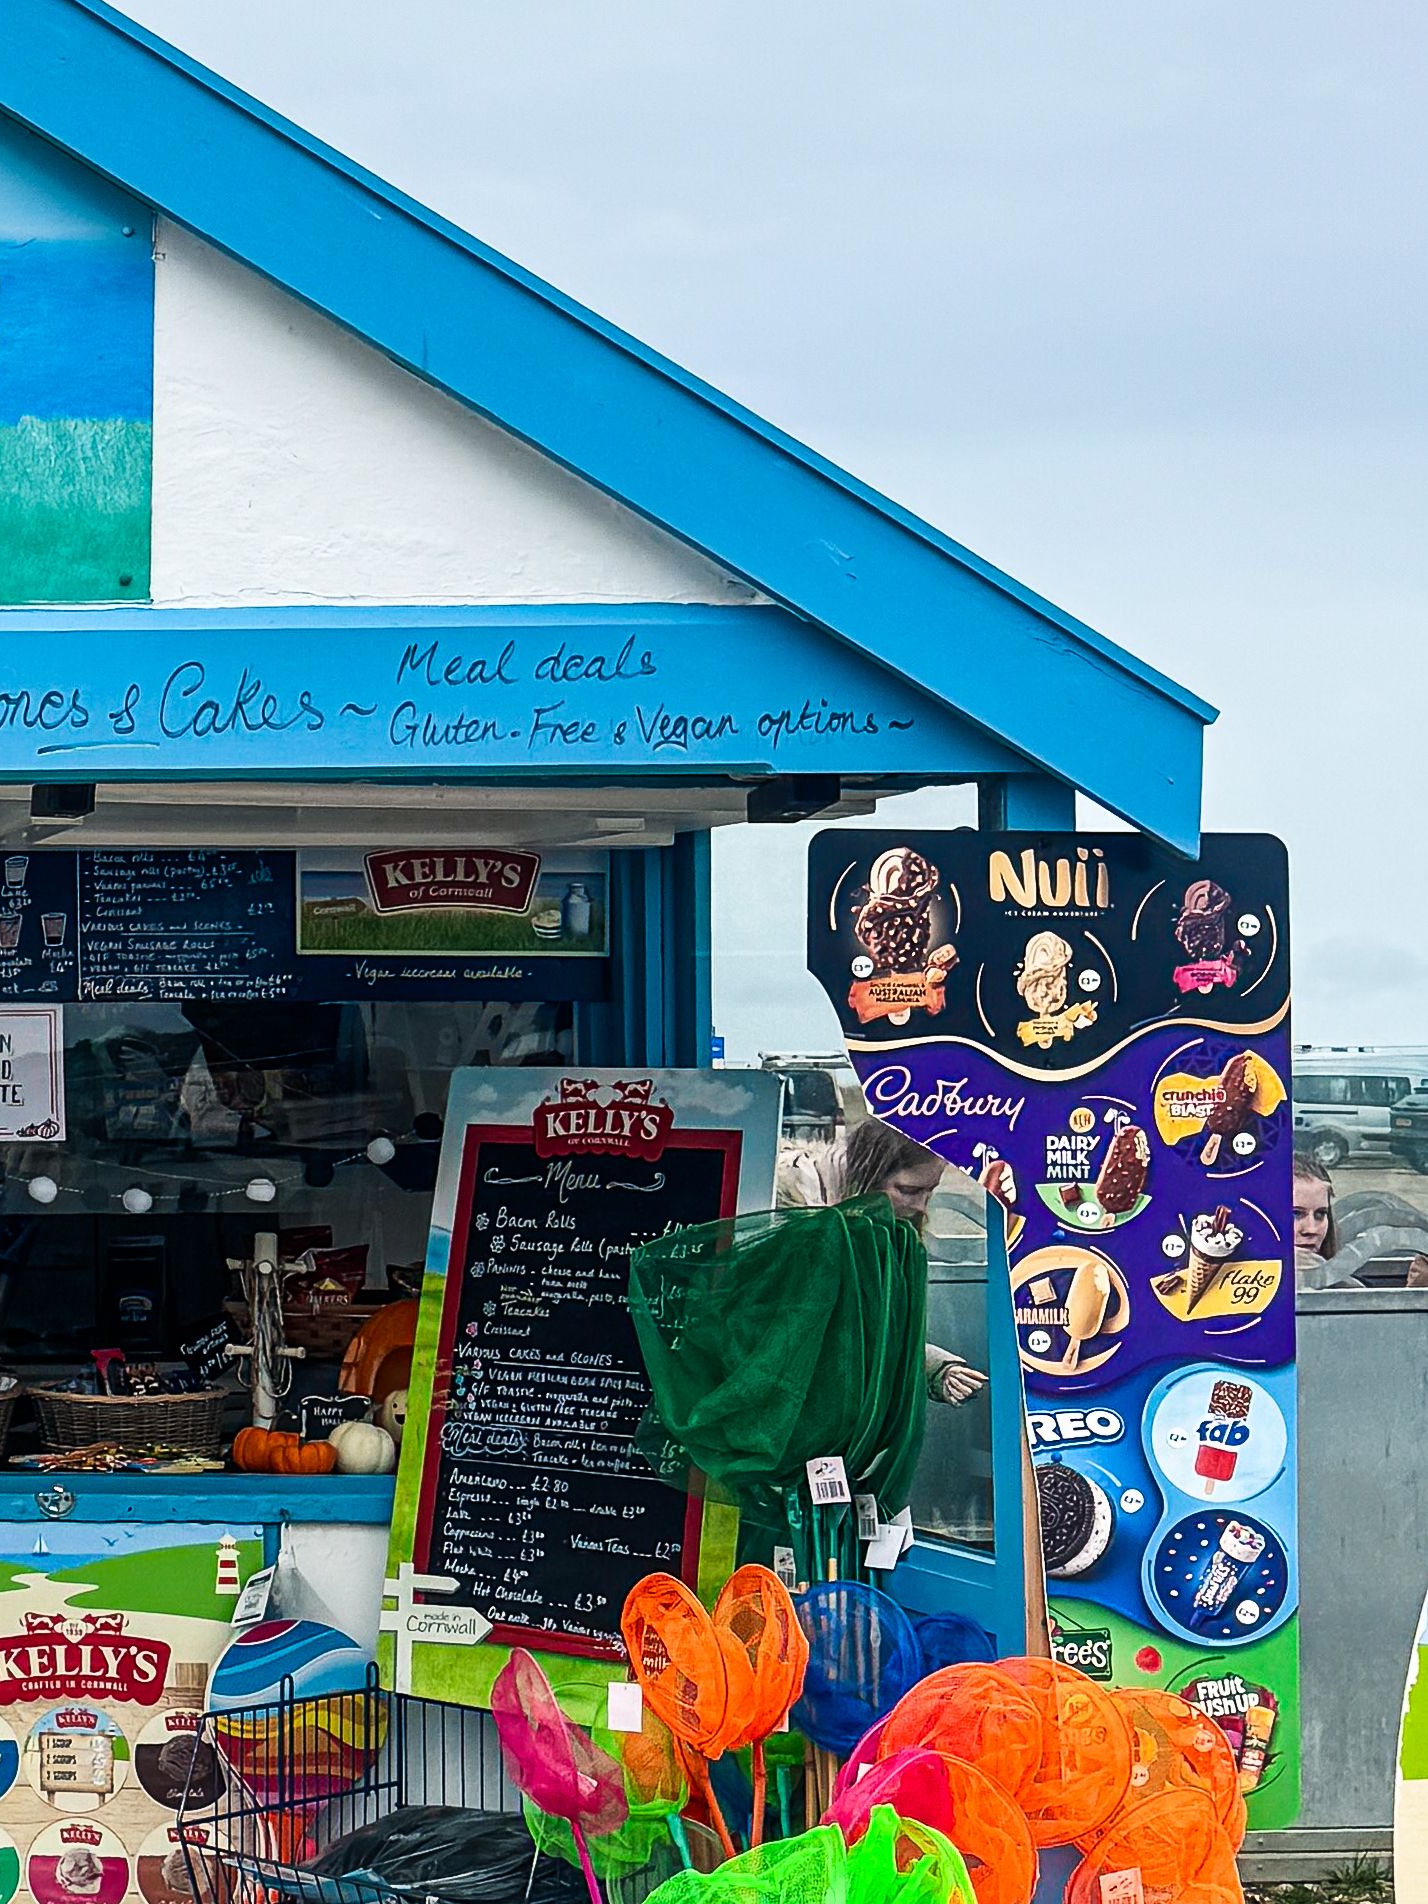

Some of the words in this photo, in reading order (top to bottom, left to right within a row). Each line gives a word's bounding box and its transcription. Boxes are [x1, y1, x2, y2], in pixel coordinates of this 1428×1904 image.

[396, 641, 518, 686] Meal
[535, 635, 656, 683] deals
[160, 661, 324, 738] Cakes
[637, 704, 737, 752] Vegan
[758, 699, 878, 751] options
[382, 856, 522, 889] KELLY'S
[989, 847, 1110, 908] Nuii
[409, 886, 425, 900] of
[868, 987, 927, 998] AUSTRALIAN
[862, 1066, 1025, 1131] Cadbury
[1162, 1088, 1226, 1104] crunchie
[546, 1109, 660, 1140] KELLY'S
[1046, 1135, 1100, 1150] DAIRY
[1046, 1150, 1091, 1166] MILK
[544, 1161, 601, 1204] Menu
[1046, 1166, 1091, 1179] MINT
[510, 1234, 565, 1260] Sausage
[1219, 1270, 1274, 1291] flake
[1230, 1285, 1259, 1304] 99
[1028, 1414, 1121, 1447] REO
[1196, 1419, 1251, 1446] fab
[406, 1615, 476, 1635] Cornwall
[80, 1681, 127, 1692] CORNWALL
